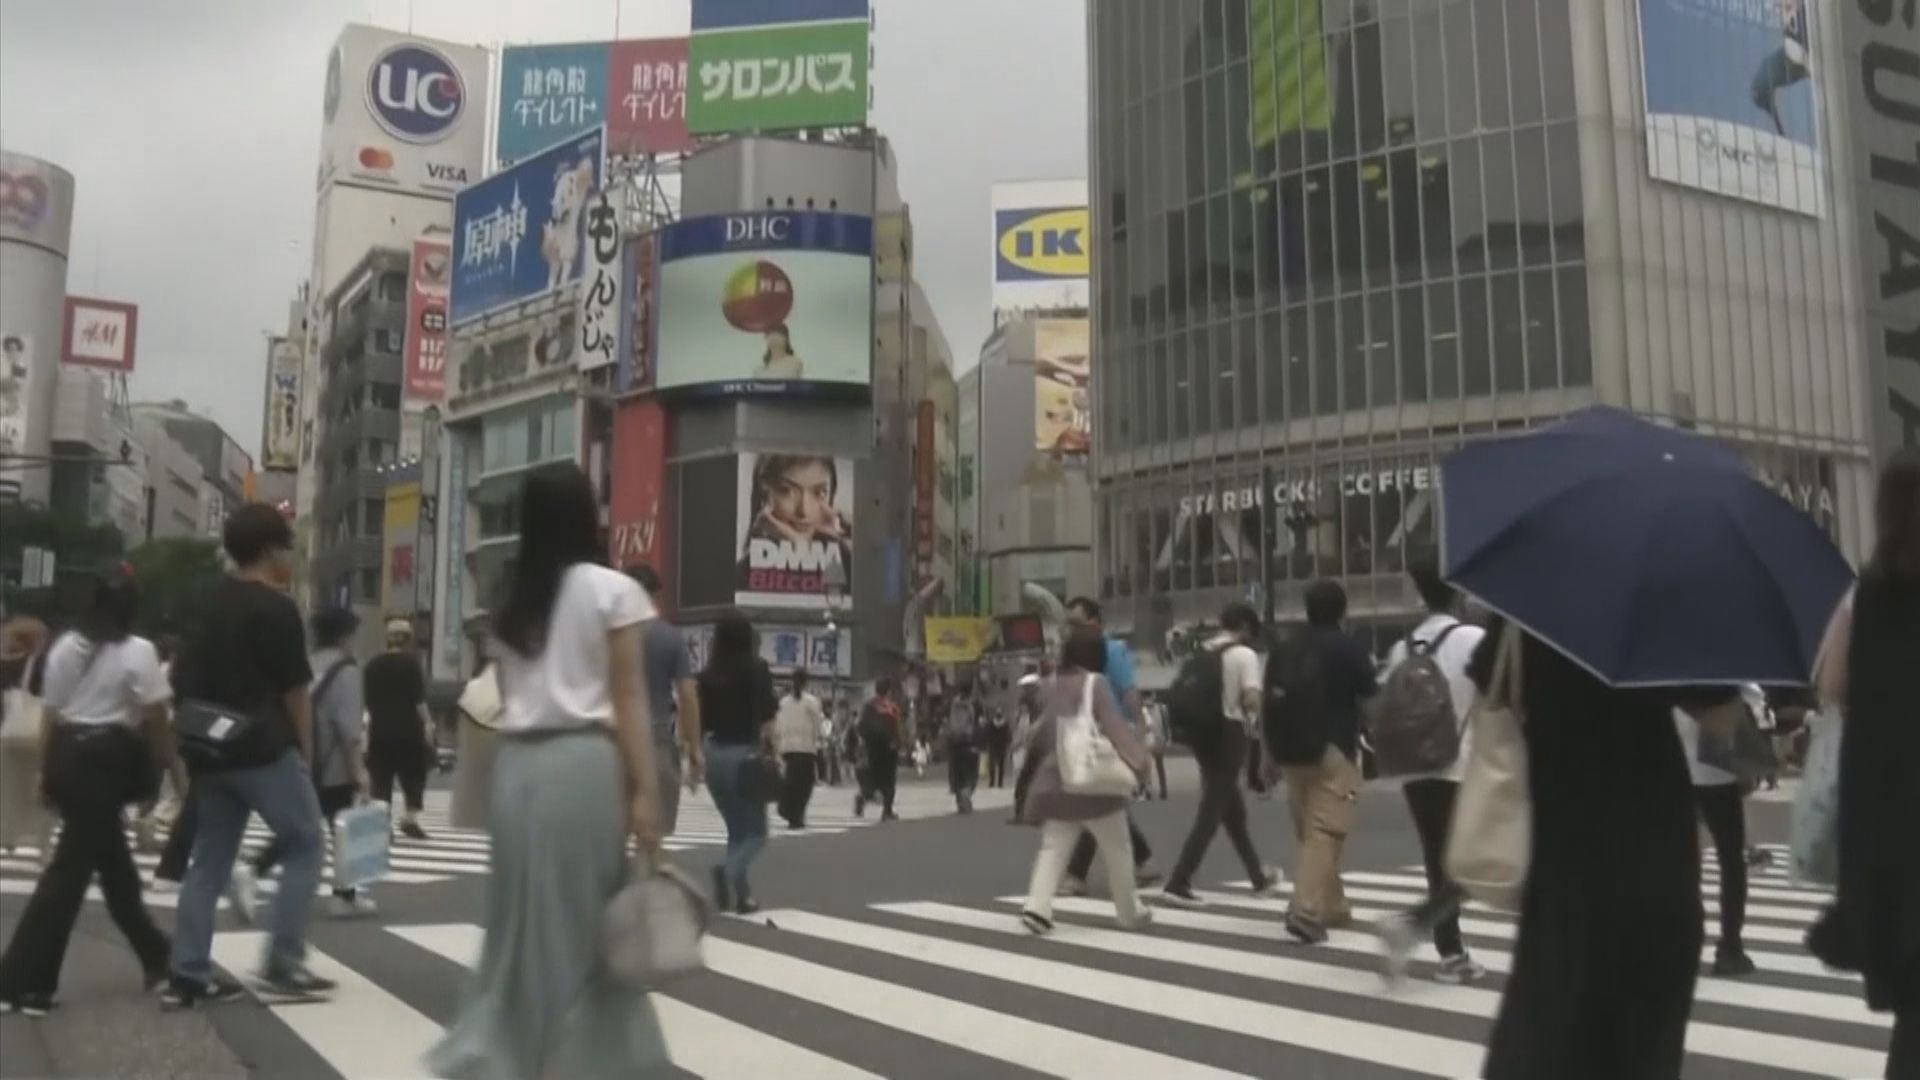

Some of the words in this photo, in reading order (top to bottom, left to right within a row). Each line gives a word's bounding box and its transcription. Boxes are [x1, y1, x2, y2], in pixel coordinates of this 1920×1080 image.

[700, 52, 855, 101] サロンパス
[427, 161, 467, 182] VISA
[725, 216, 790, 241] DHC
[583, 193, 620, 360] もんじゃ
[750, 538, 844, 571] DMM
[749, 571, 834, 592] Bitcoi
